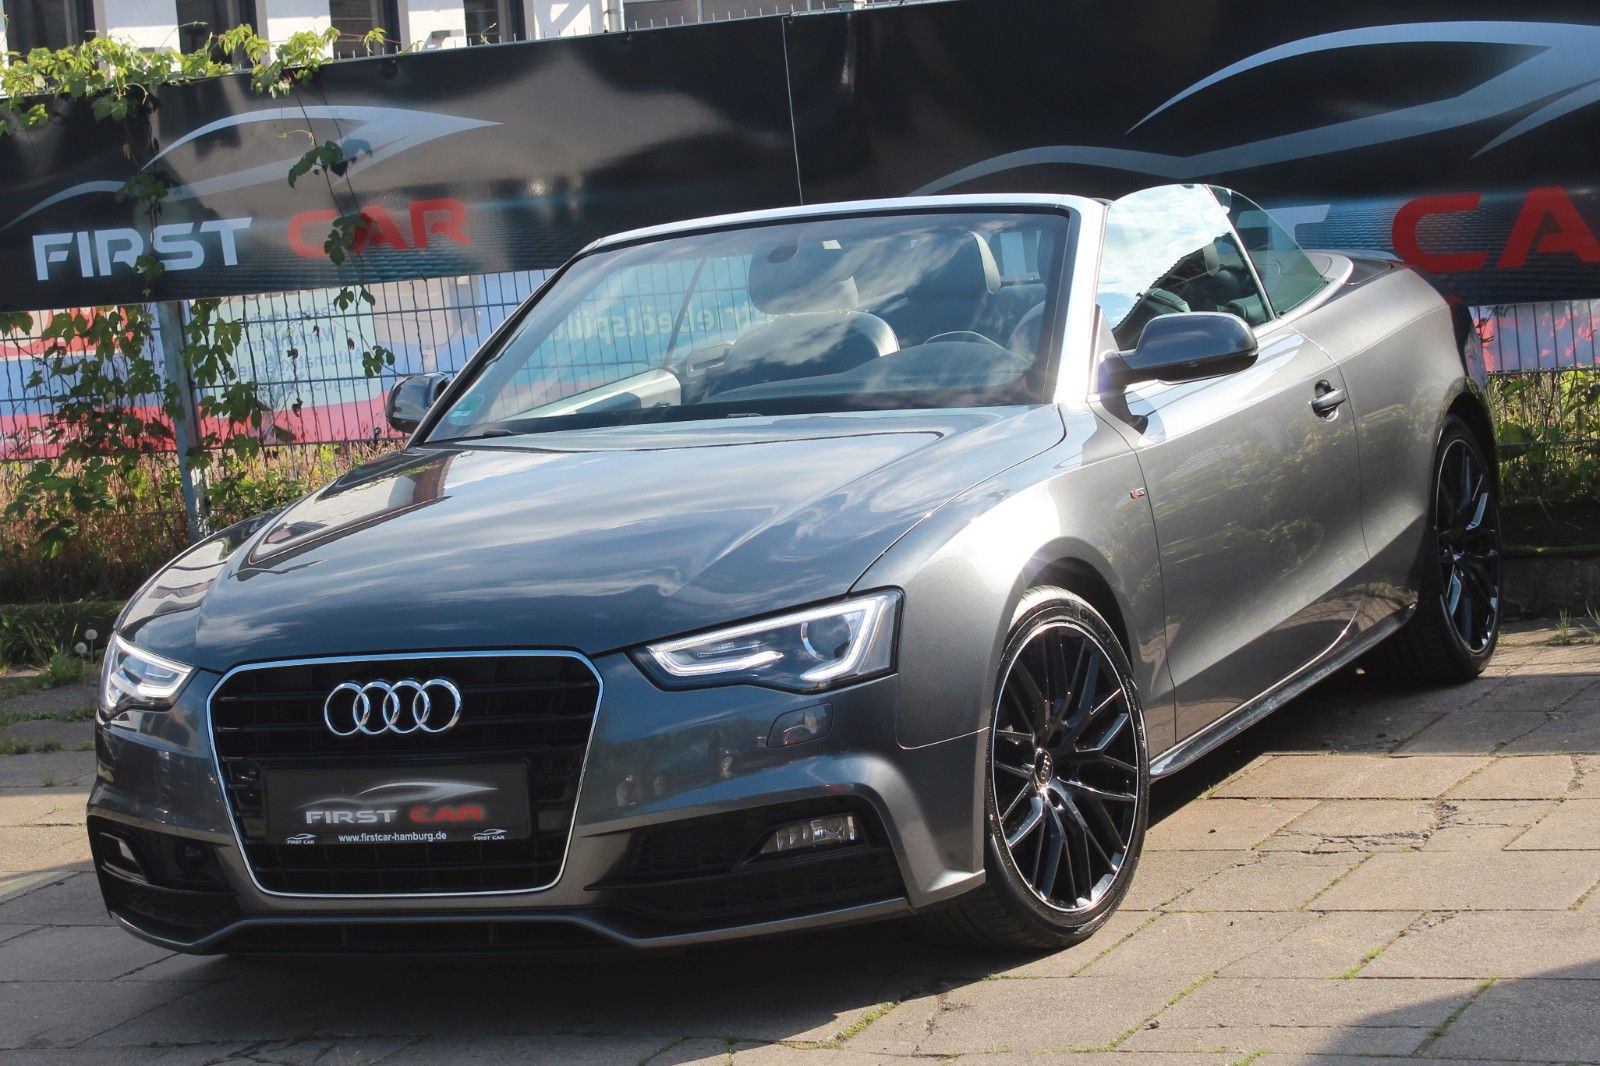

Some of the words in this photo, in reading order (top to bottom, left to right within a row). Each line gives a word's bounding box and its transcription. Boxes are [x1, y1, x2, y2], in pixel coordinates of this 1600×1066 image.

[32, 216, 253, 281] FIRST
[287, 196, 473, 257] CAR
[305, 809, 398, 824] FIRST
[409, 806, 482, 823] CAR
[338, 831, 447, 843] www.firstcar-hamburg.de
